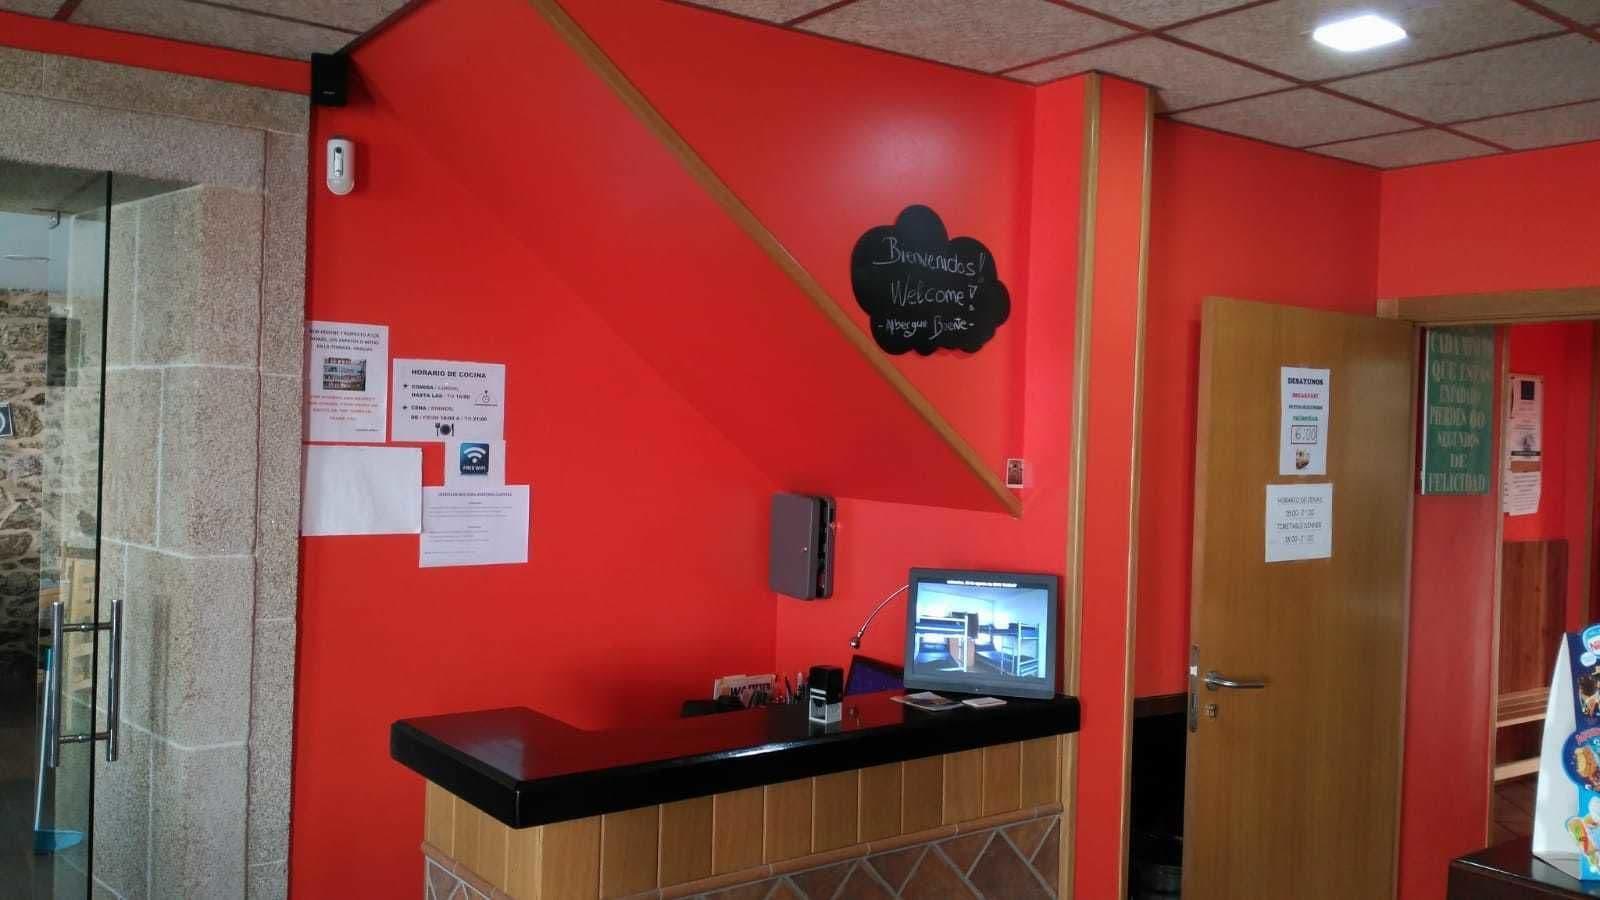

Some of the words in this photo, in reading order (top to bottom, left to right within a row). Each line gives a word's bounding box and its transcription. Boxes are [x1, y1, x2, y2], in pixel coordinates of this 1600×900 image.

[872, 236, 986, 283] Bienvenidos!
[890, 272, 978, 311] Welcome!
[411, 369, 446, 377] HORARIO
[458, 371, 487, 379] COCINA
[1287, 377, 1324, 386] DESAYUNOS
